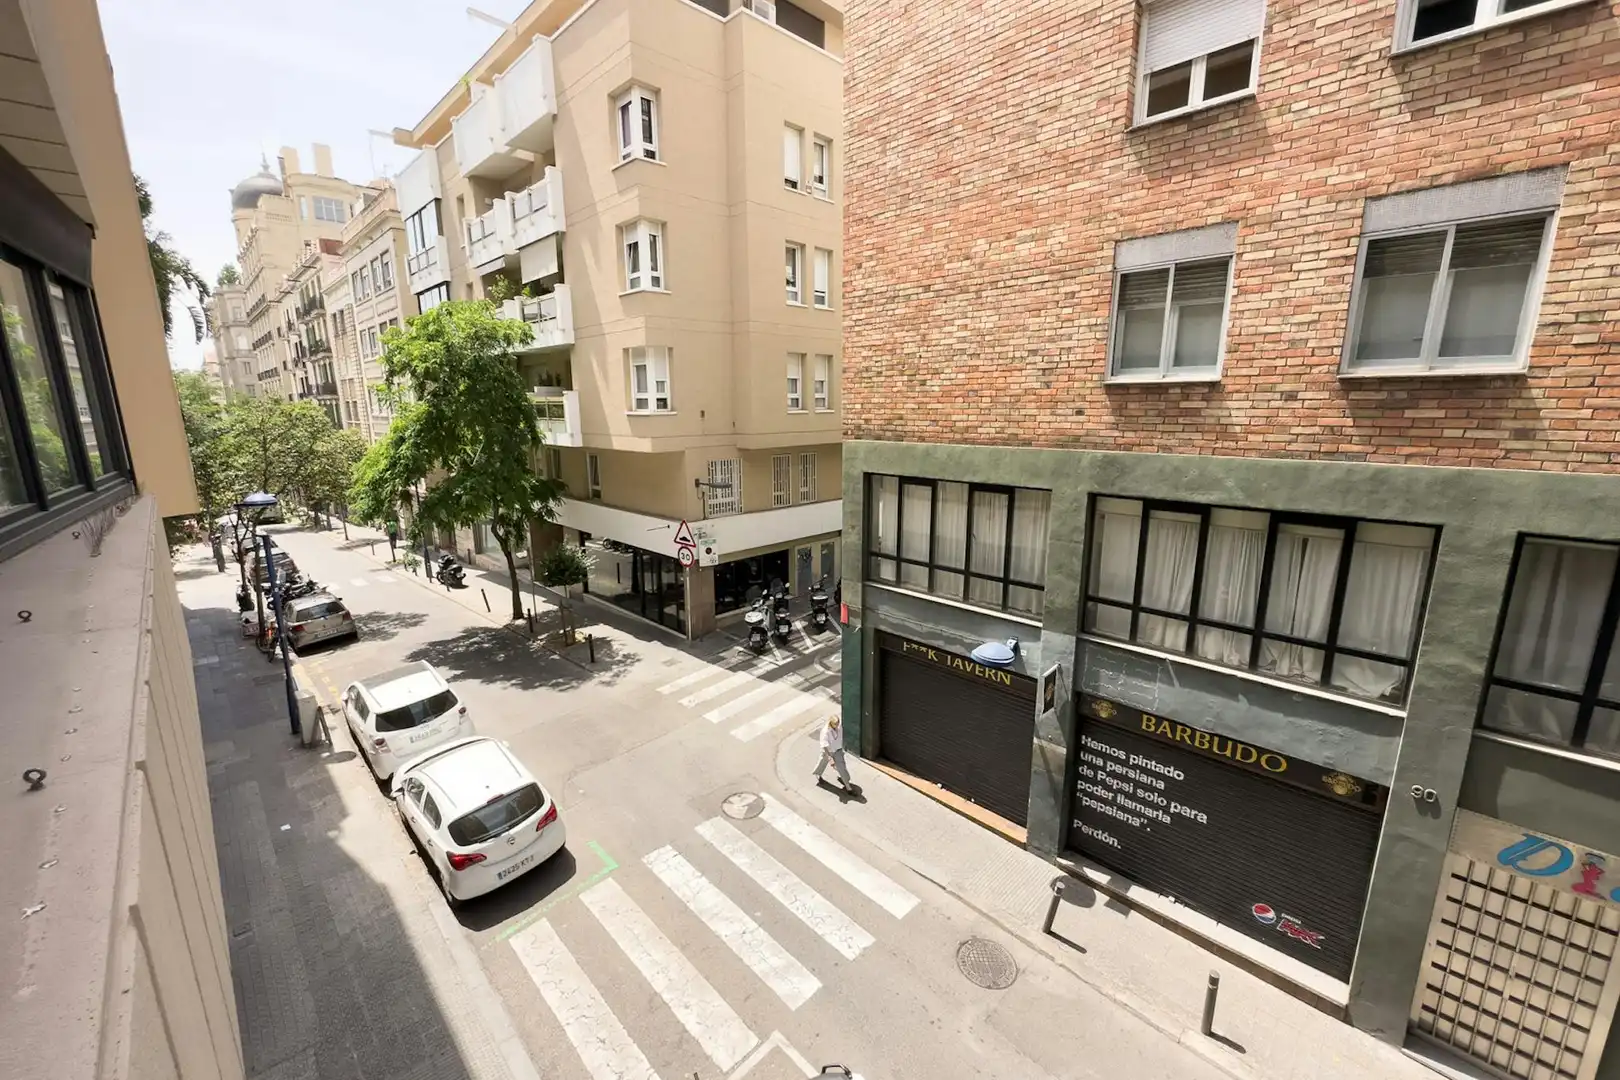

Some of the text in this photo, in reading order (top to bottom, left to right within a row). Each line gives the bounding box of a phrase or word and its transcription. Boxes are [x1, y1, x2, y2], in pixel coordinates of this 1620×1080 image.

[680, 552, 691, 561] 30
[1081, 735, 1185, 780] Hemos pintado
[1141, 713, 1288, 773] BARBUDO
[1080, 751, 1165, 790] una persiana
[1077, 780, 1171, 825] poder llamarla
[1078, 765, 1208, 825] de Pepsi solo para
[1410, 784, 1437, 803] 90
[1073, 819, 1122, 850] Perdón.
